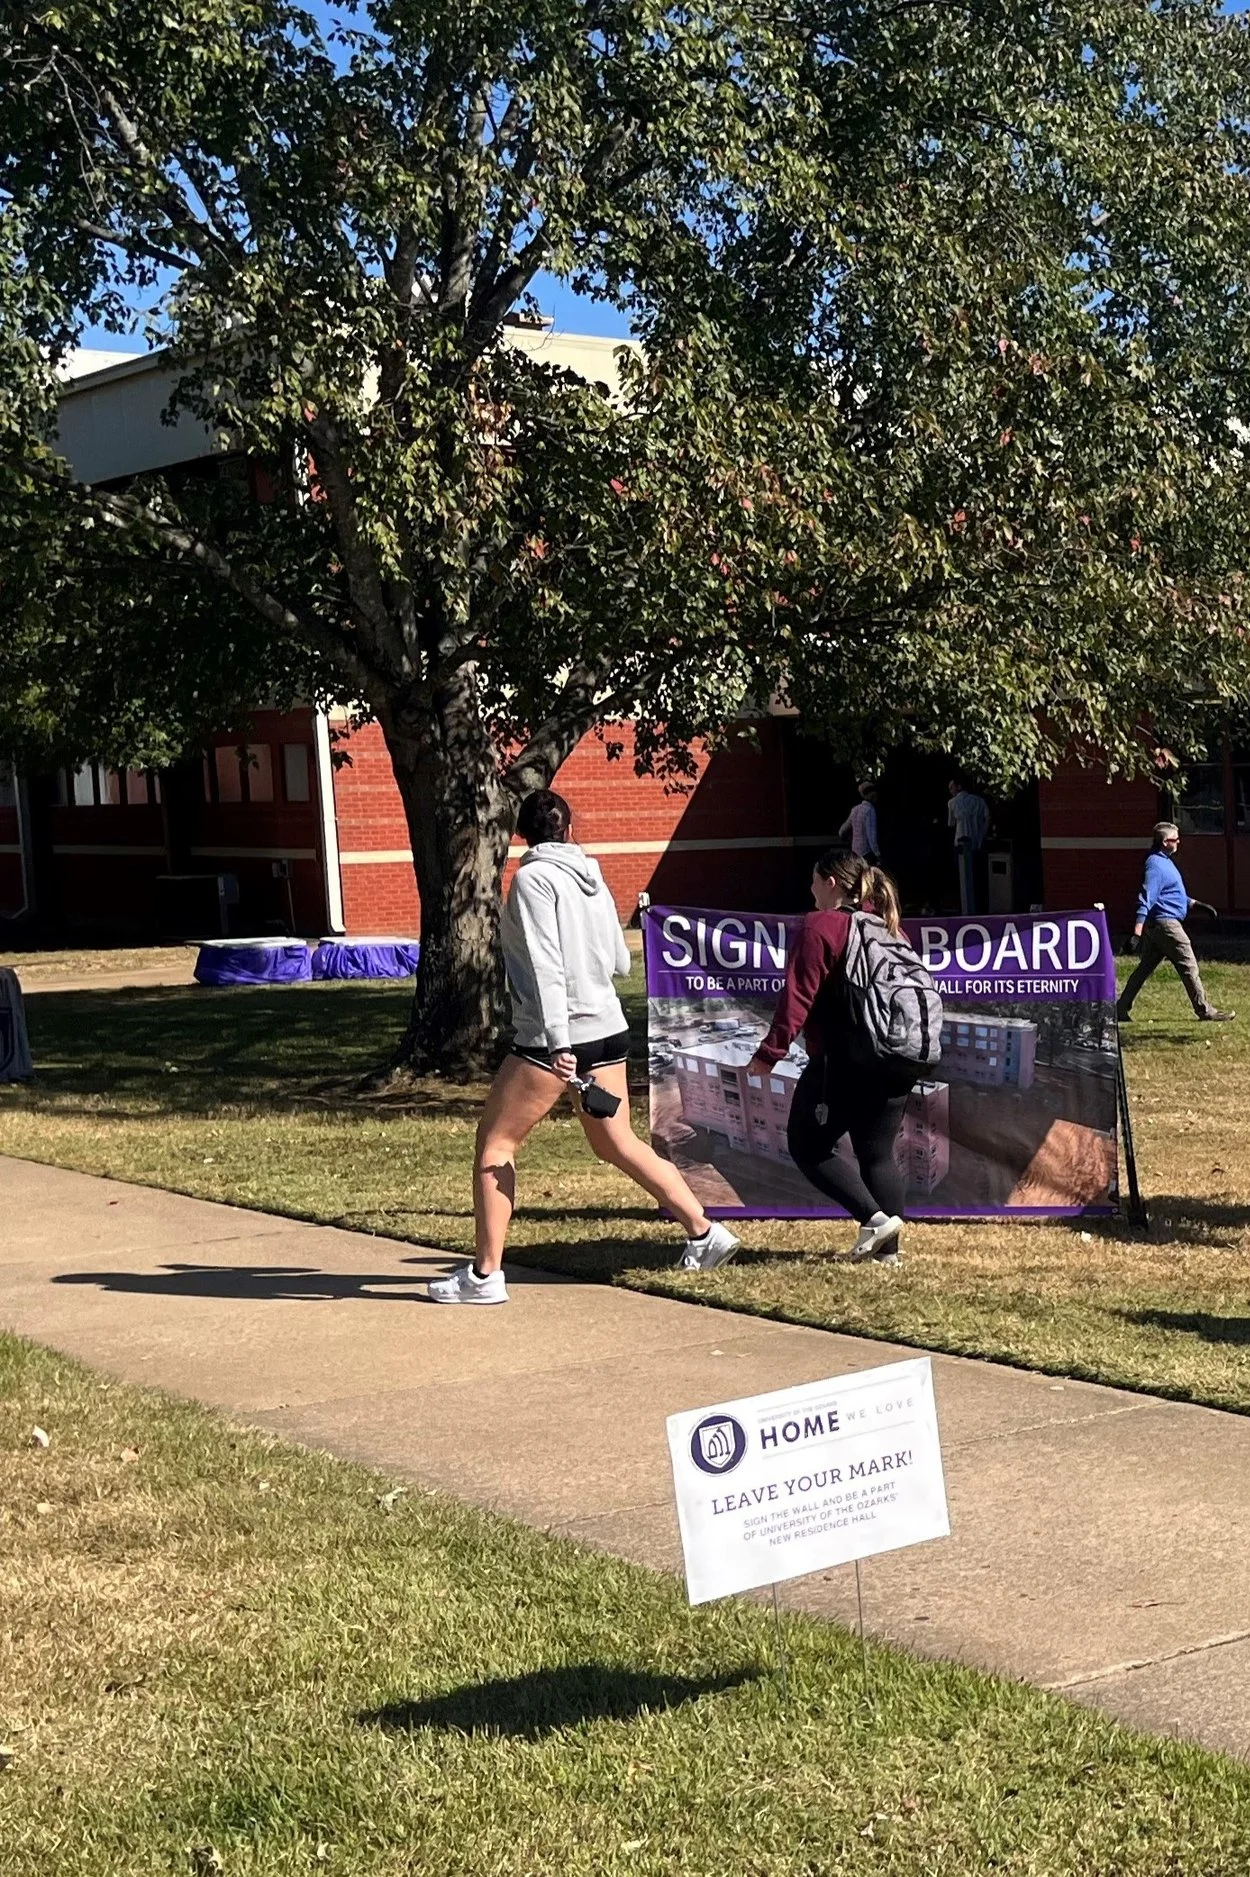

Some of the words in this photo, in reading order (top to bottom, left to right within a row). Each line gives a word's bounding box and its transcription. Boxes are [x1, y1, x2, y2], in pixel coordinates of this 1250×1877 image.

[662, 914, 786, 969] SIGN
[920, 919, 1100, 972] BOARD
[686, 976, 704, 990] TO
[707, 976, 724, 991] BE
[727, 977, 736, 991] A
[738, 978, 768, 992] PART
[935, 980, 963, 994] ALL
[965, 979, 991, 994] FOR
[994, 979, 1014, 994] ITS
[1019, 979, 1079, 994] ETERNITY
[760, 1410, 840, 1450] HOME
[846, 1409, 867, 1421] WE
[876, 1397, 914, 1415] LOVE
[711, 1484, 779, 1515] LEAVE
[784, 1468, 843, 1496] YOUR
[849, 1450, 914, 1480] MARK!
[743, 1515, 768, 1528] SIGN
[771, 1509, 789, 1520] THE
[792, 1503, 820, 1515] WALL
[823, 1495, 842, 1508] AND
[845, 1491, 859, 1503] BE
[861, 1489, 868, 1497] A
[870, 1481, 896, 1495] PART
[743, 1529, 757, 1541] OF
[760, 1515, 816, 1537] UNIVERSITY
[819, 1510, 833, 1521] OF
[836, 1504, 854, 1516] THE
[769, 1534, 791, 1546] NEW
[794, 1516, 849, 1540] RESIDENCE
[852, 1511, 876, 1525] HALL
